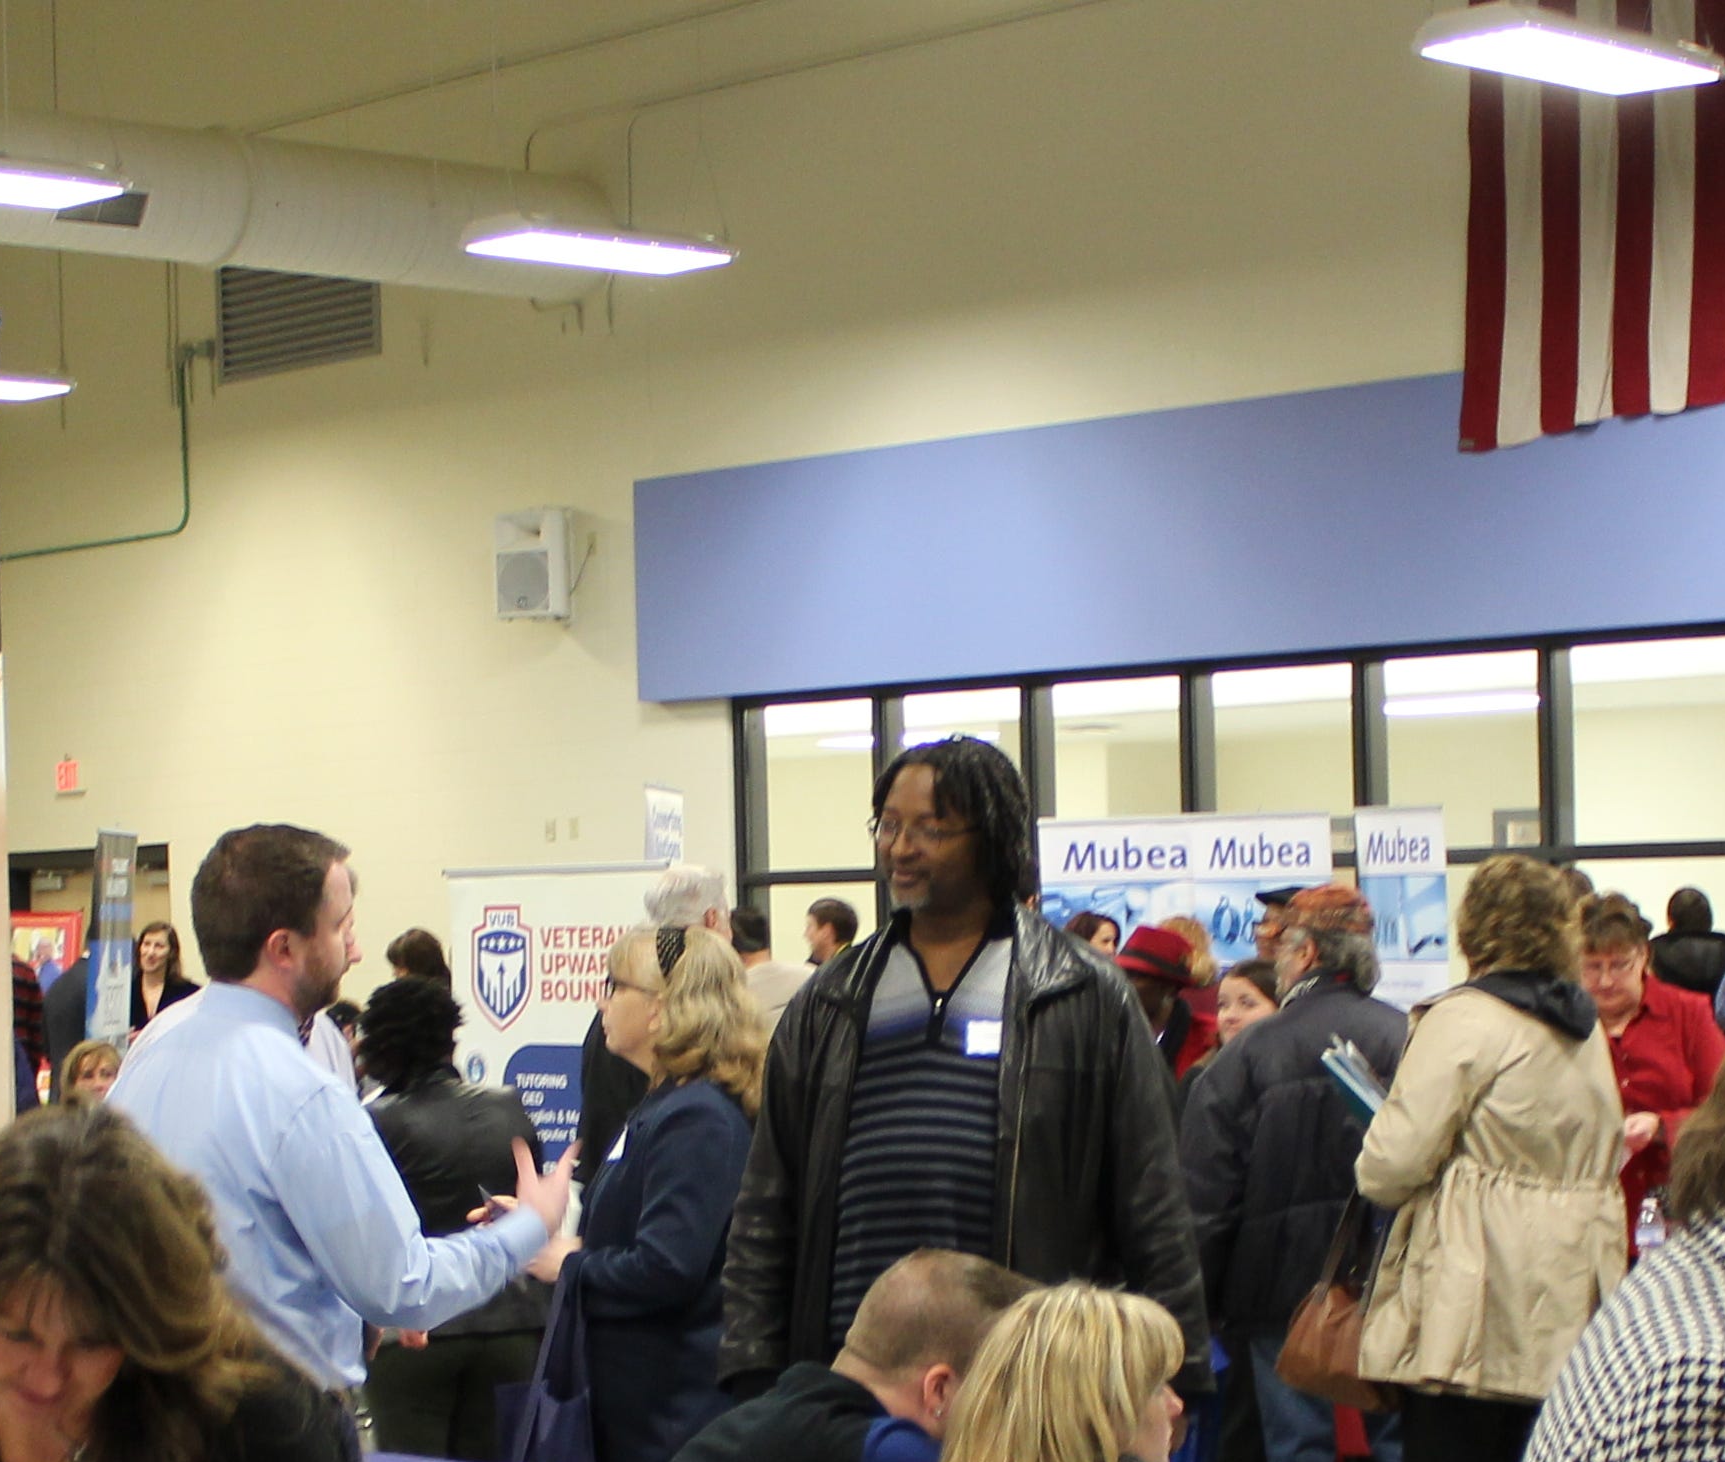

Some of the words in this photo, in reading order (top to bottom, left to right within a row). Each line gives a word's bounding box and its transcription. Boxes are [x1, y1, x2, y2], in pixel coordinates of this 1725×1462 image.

[1063, 836, 1188, 873] Mubea
[1209, 831, 1312, 870] Mubea
[1365, 827, 1431, 866] Mubea
[488, 911, 516, 927] VUB
[515, 1073, 568, 1089] TUTORING
